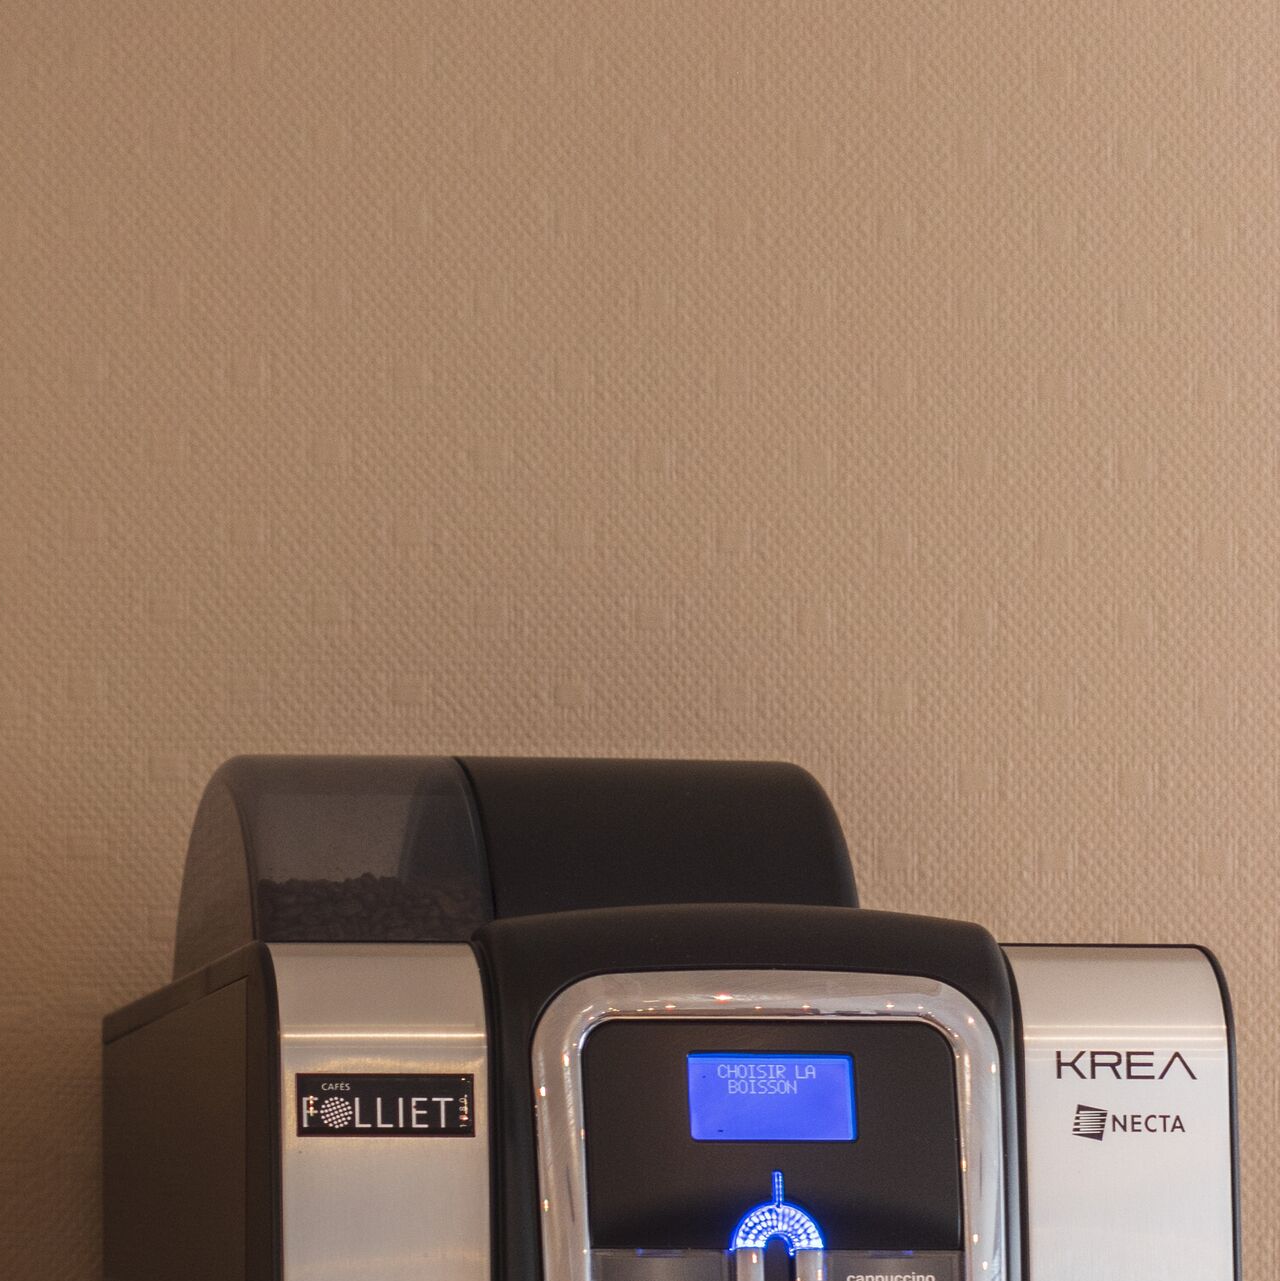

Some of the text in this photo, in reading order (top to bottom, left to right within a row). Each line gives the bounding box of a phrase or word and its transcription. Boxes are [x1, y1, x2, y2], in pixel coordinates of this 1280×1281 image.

[717, 1064, 816, 1079] CHOISIR LA
[1055, 1050, 1198, 1080] KREA
[727, 1080, 798, 1094] BOISSON
[1111, 1114, 1186, 1133] NECTA
